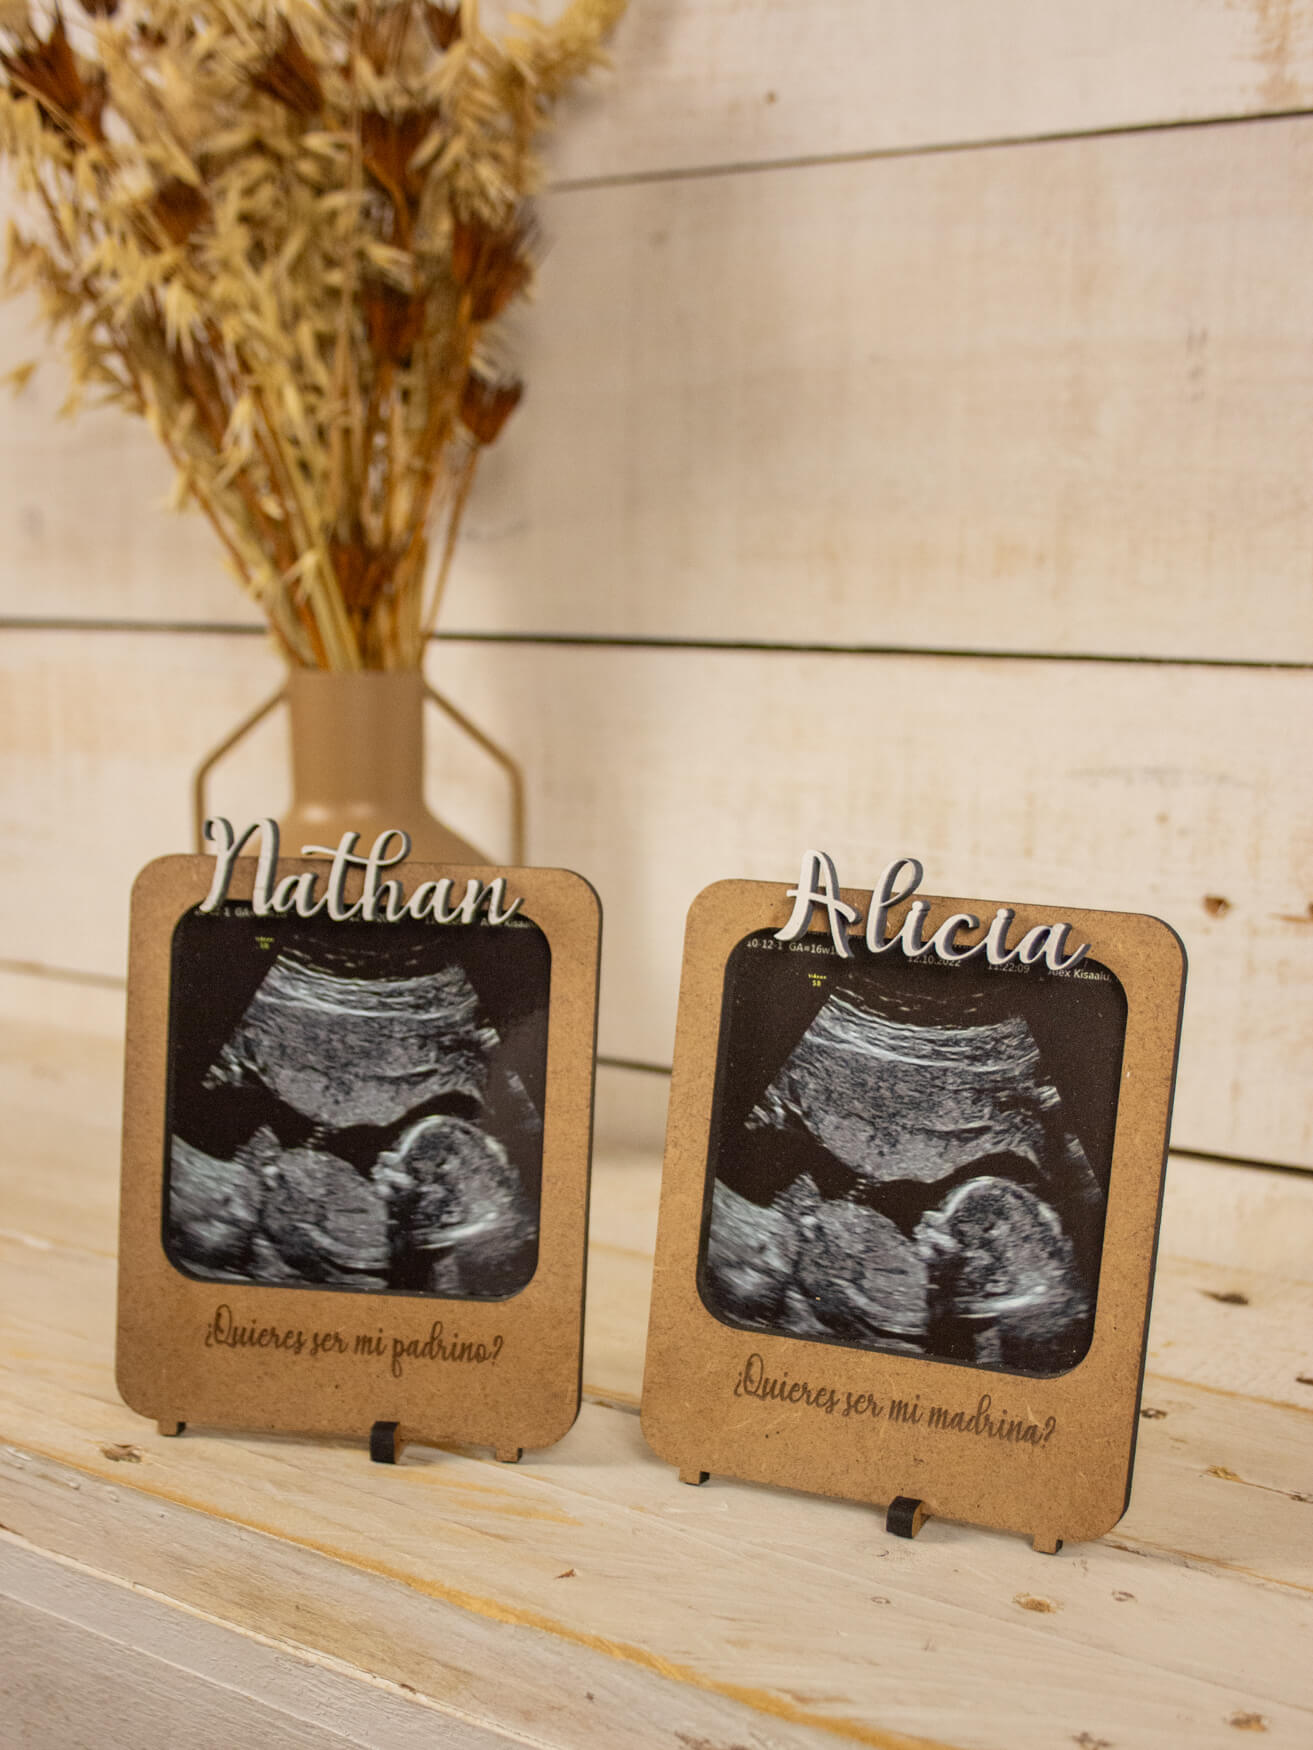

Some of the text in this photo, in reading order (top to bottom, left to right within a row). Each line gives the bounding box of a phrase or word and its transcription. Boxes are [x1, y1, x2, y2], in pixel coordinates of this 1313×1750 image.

[200, 816, 523, 925] Nathan
[774, 849, 1092, 971] Alicia
[310, 1330, 347, 1356] ser
[353, 1328, 387, 1357] mi
[391, 1321, 504, 1378] padrino?
[841, 1391, 883, 1417] ser
[888, 1394, 923, 1424] mi
[928, 1394, 1057, 1448] madrina?
